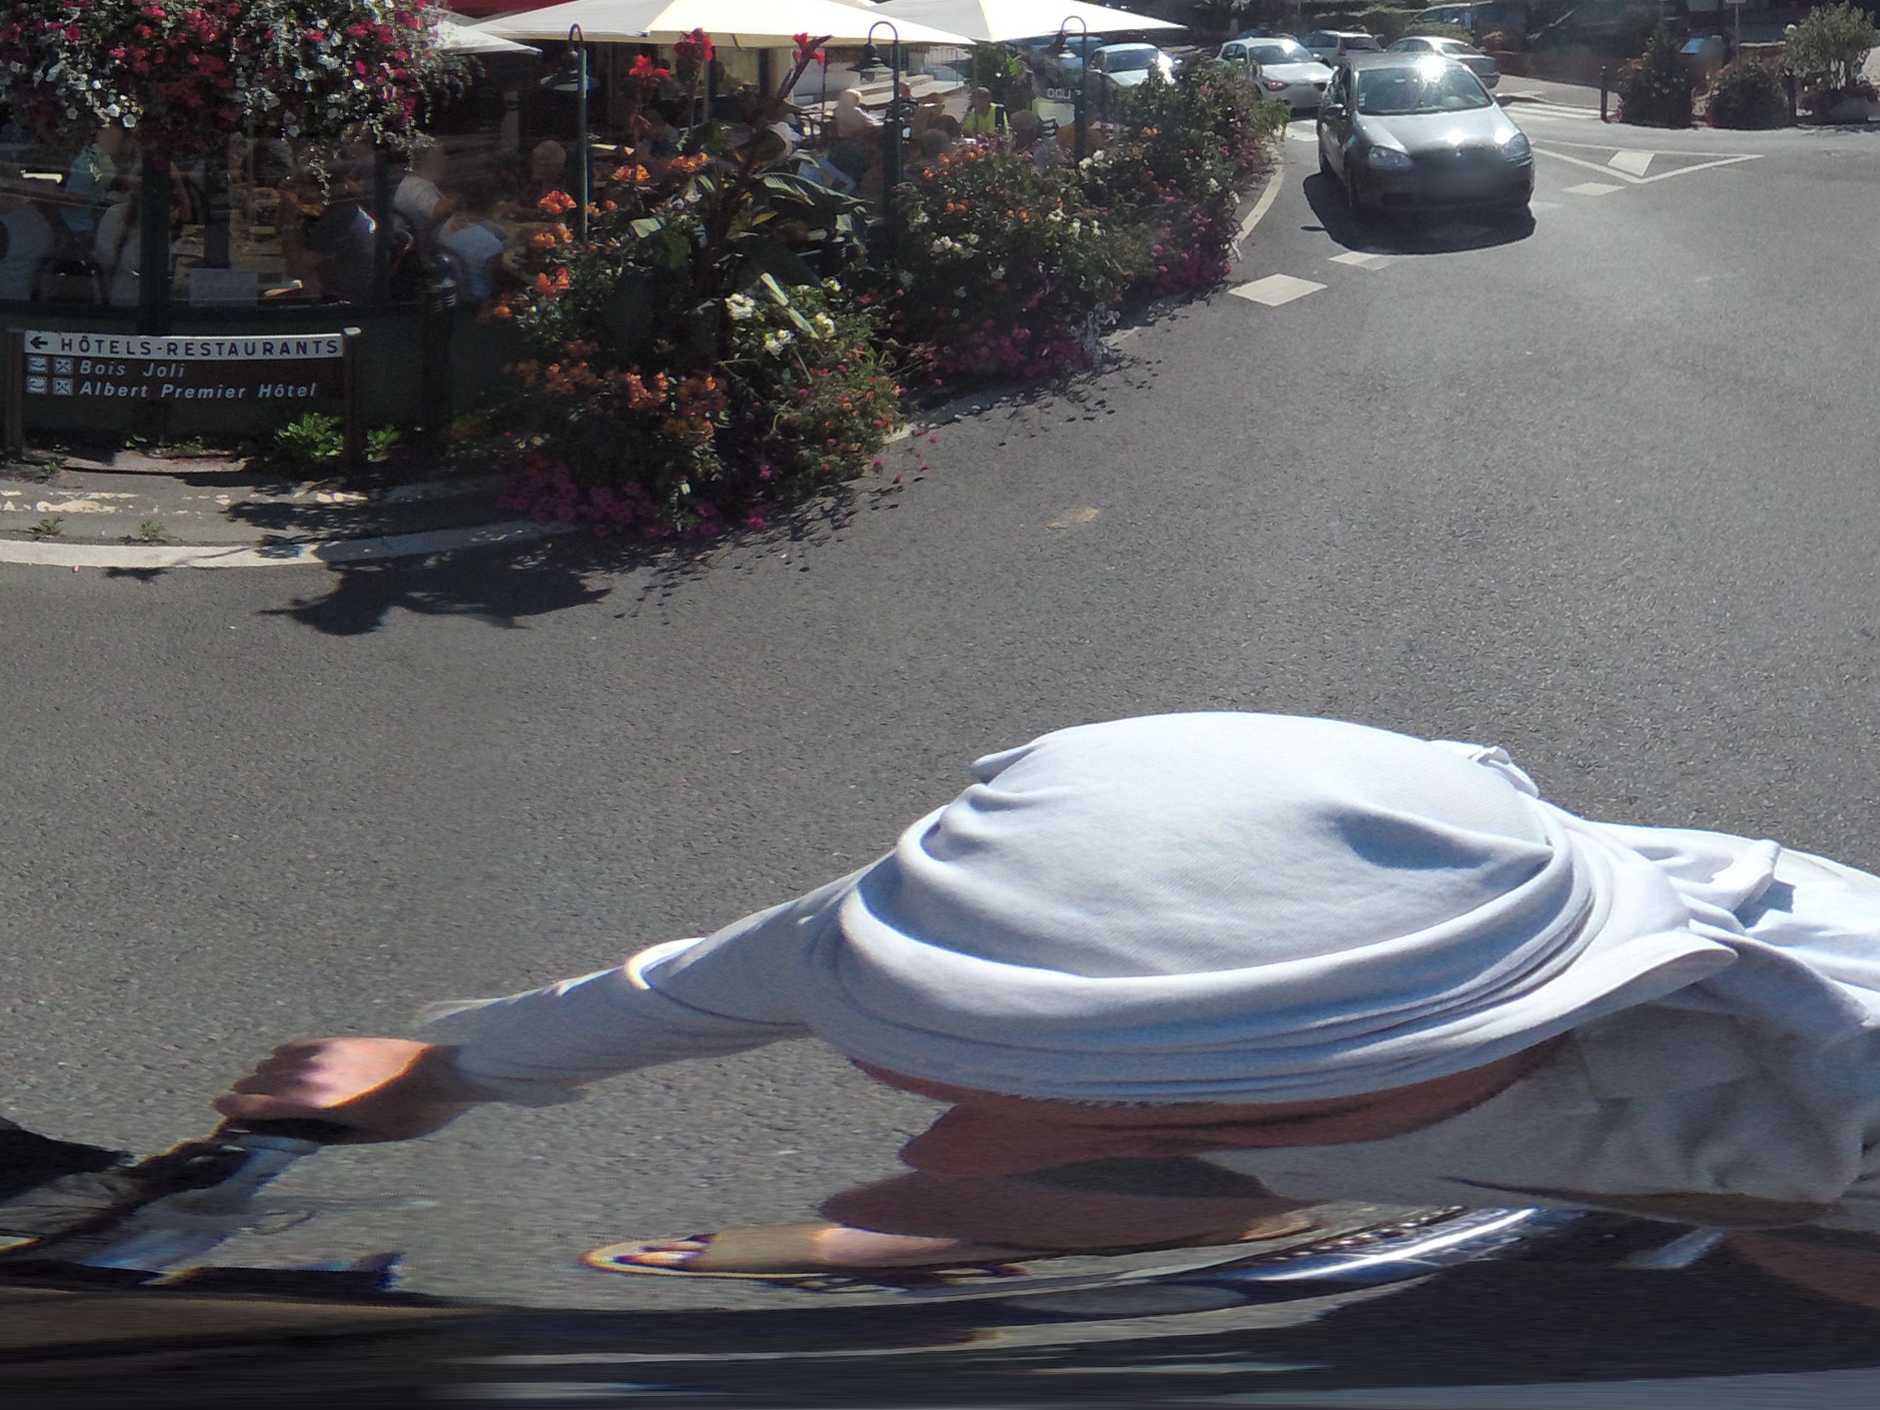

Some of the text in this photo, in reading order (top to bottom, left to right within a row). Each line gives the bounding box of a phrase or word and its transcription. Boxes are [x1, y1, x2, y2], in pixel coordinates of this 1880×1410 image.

[60, 335, 339, 357] HÔTELS-RESTAURANTS
[78, 360, 186, 378] Bois Joli
[78, 380, 318, 399] Albert Premier Hôtel
